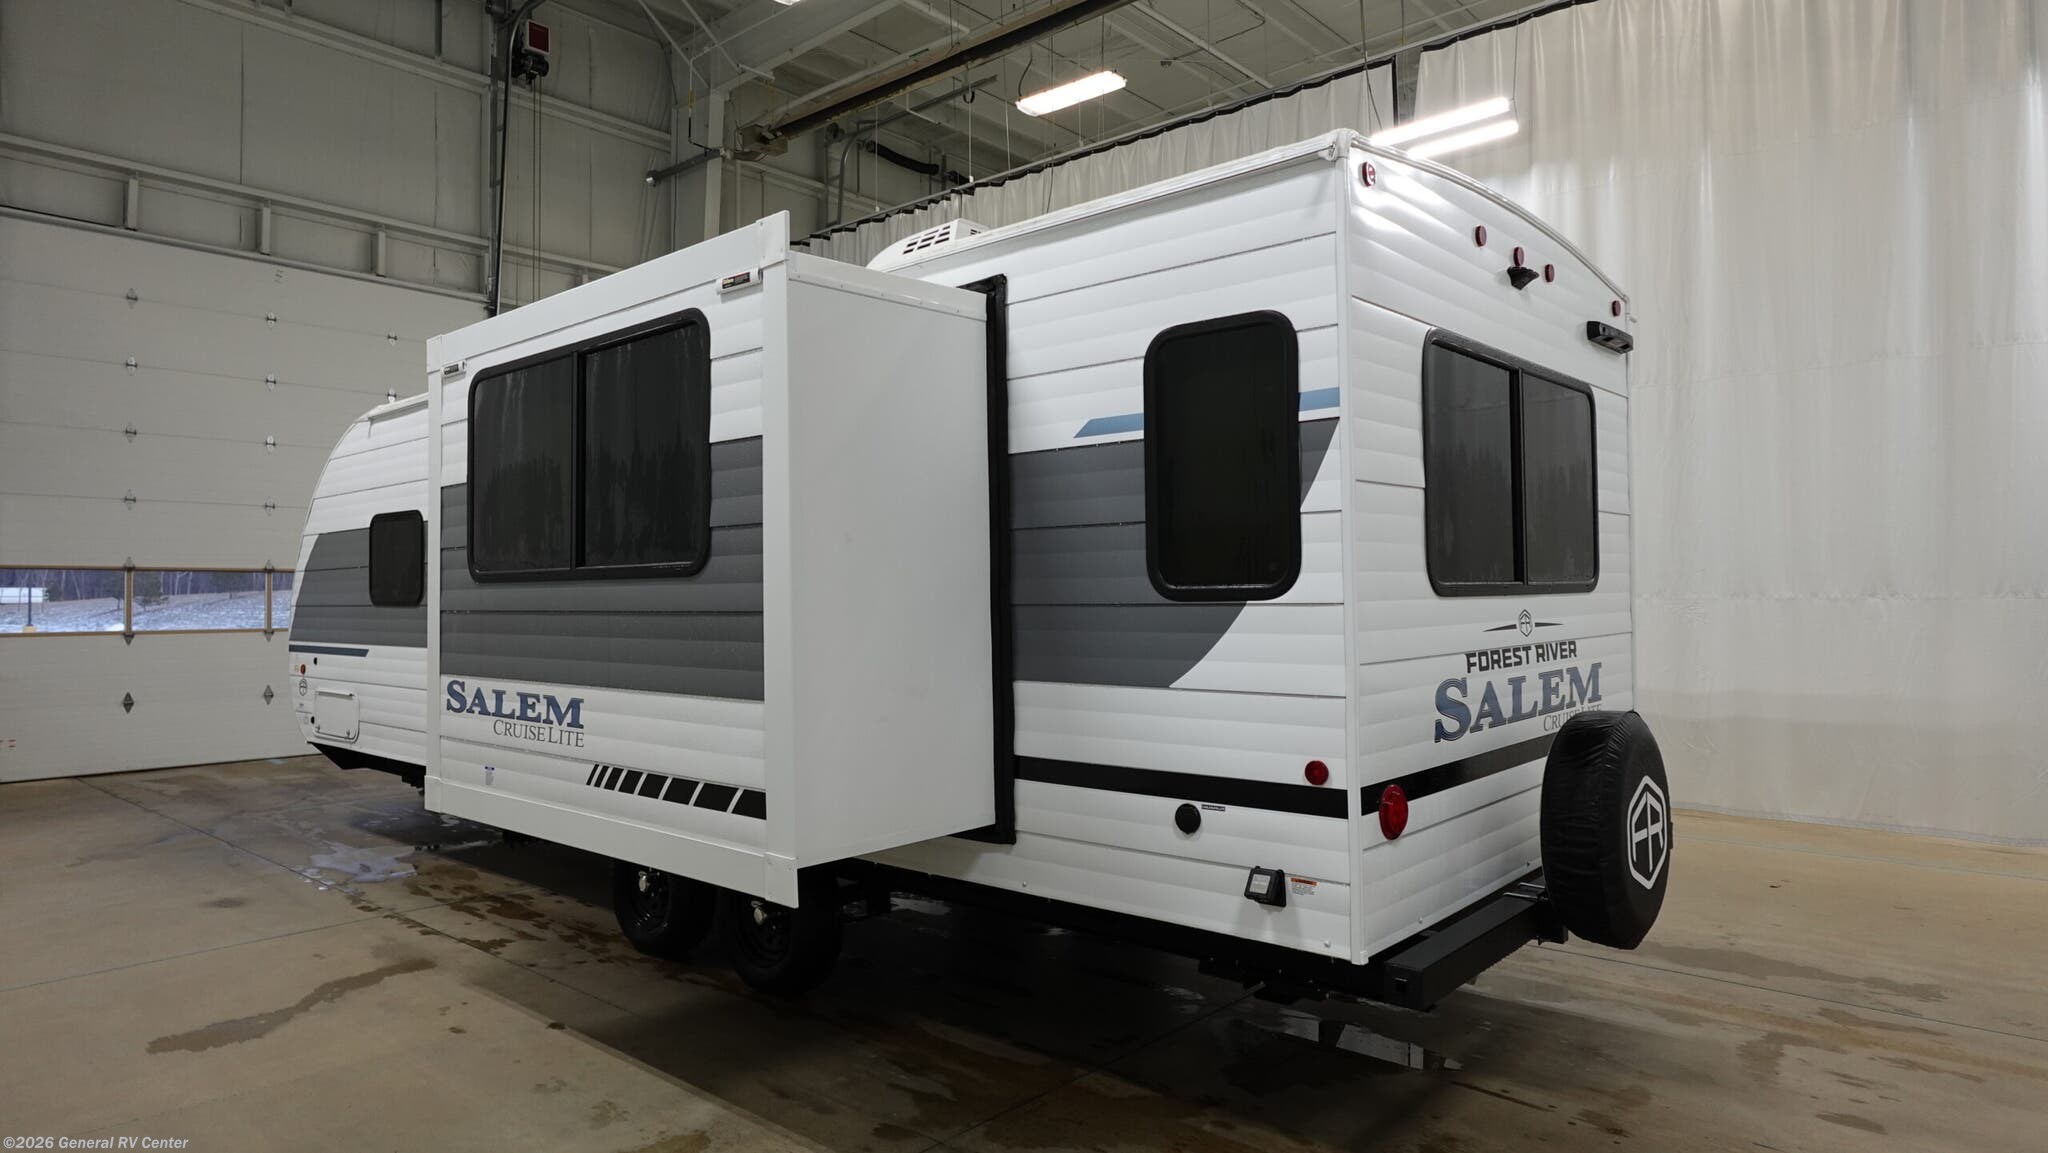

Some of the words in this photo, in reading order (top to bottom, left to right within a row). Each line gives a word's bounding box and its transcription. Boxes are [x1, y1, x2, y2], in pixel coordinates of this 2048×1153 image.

[1465, 646, 1532, 674] FOREST
[1536, 640, 1577, 663] RIVER
[446, 679, 585, 729] SALEM
[1434, 662, 1602, 744] SALEM
